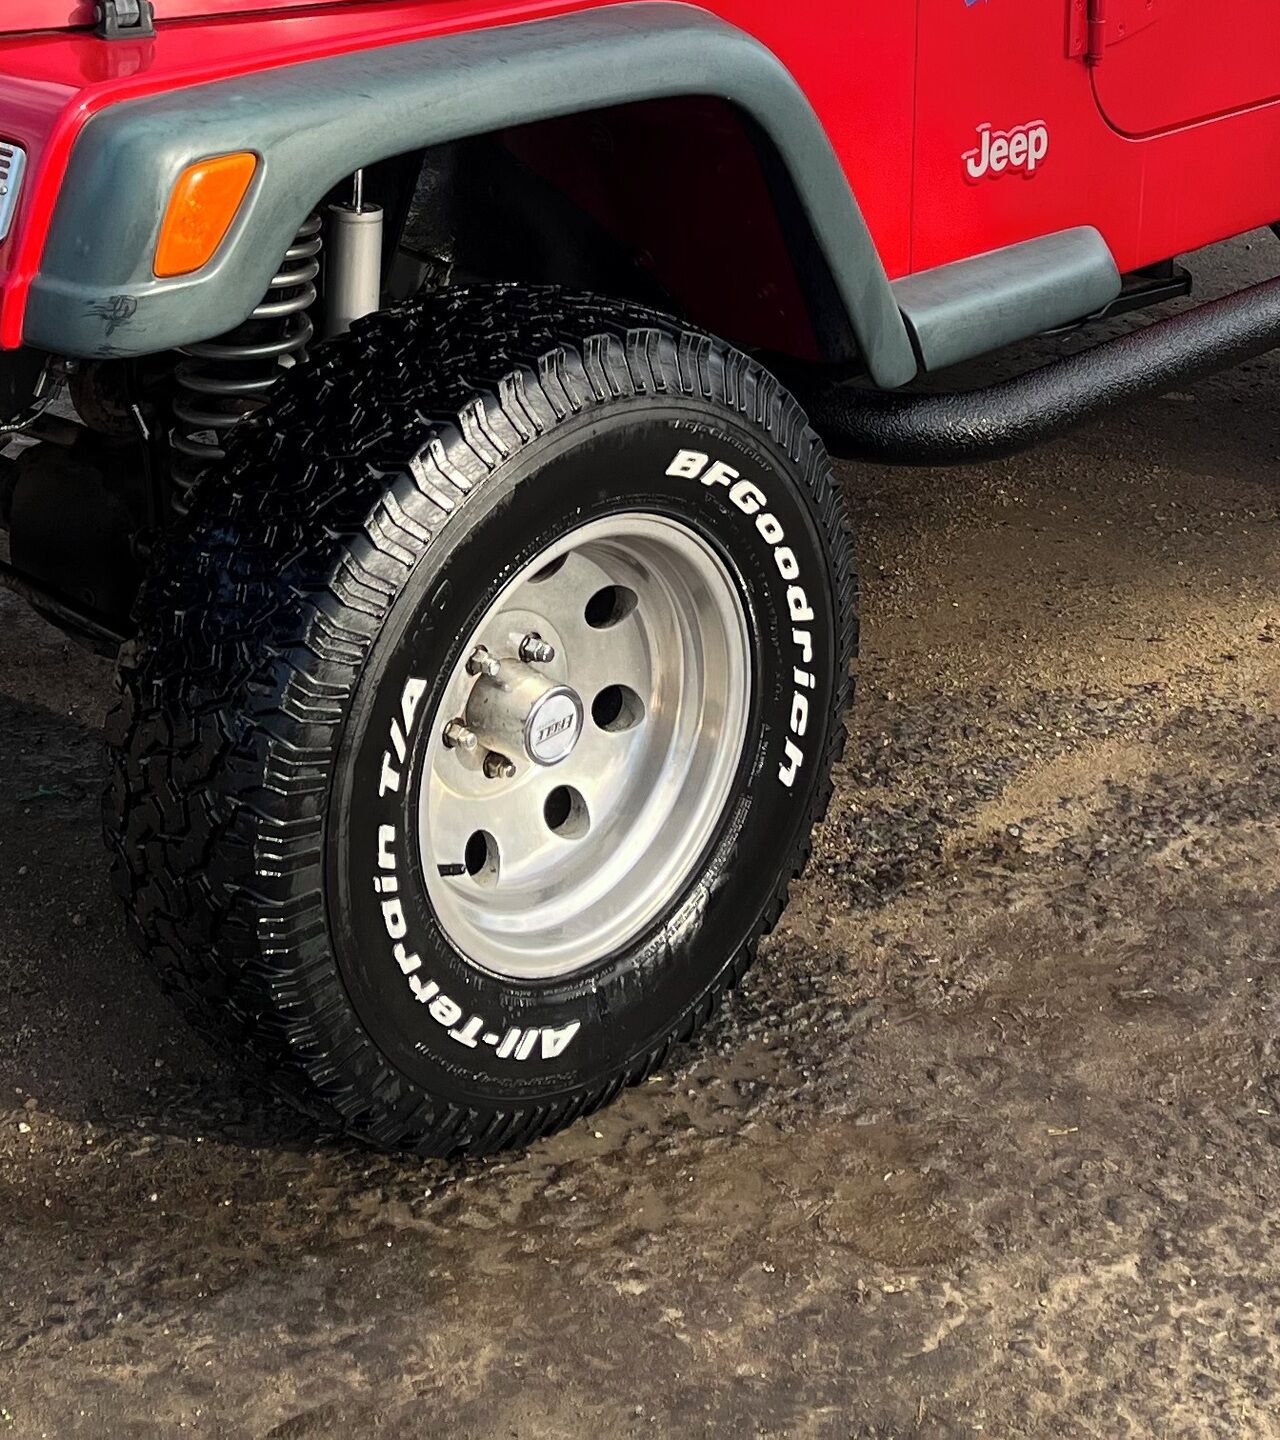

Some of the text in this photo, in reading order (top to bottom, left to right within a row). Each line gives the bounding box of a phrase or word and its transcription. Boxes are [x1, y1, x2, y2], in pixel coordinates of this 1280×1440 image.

[962, 120, 1049, 178] Jeep
[665, 448, 816, 788] BFGoodrich
[378, 675, 428, 797] T/A
[373, 823, 581, 1061] All-Terrain
